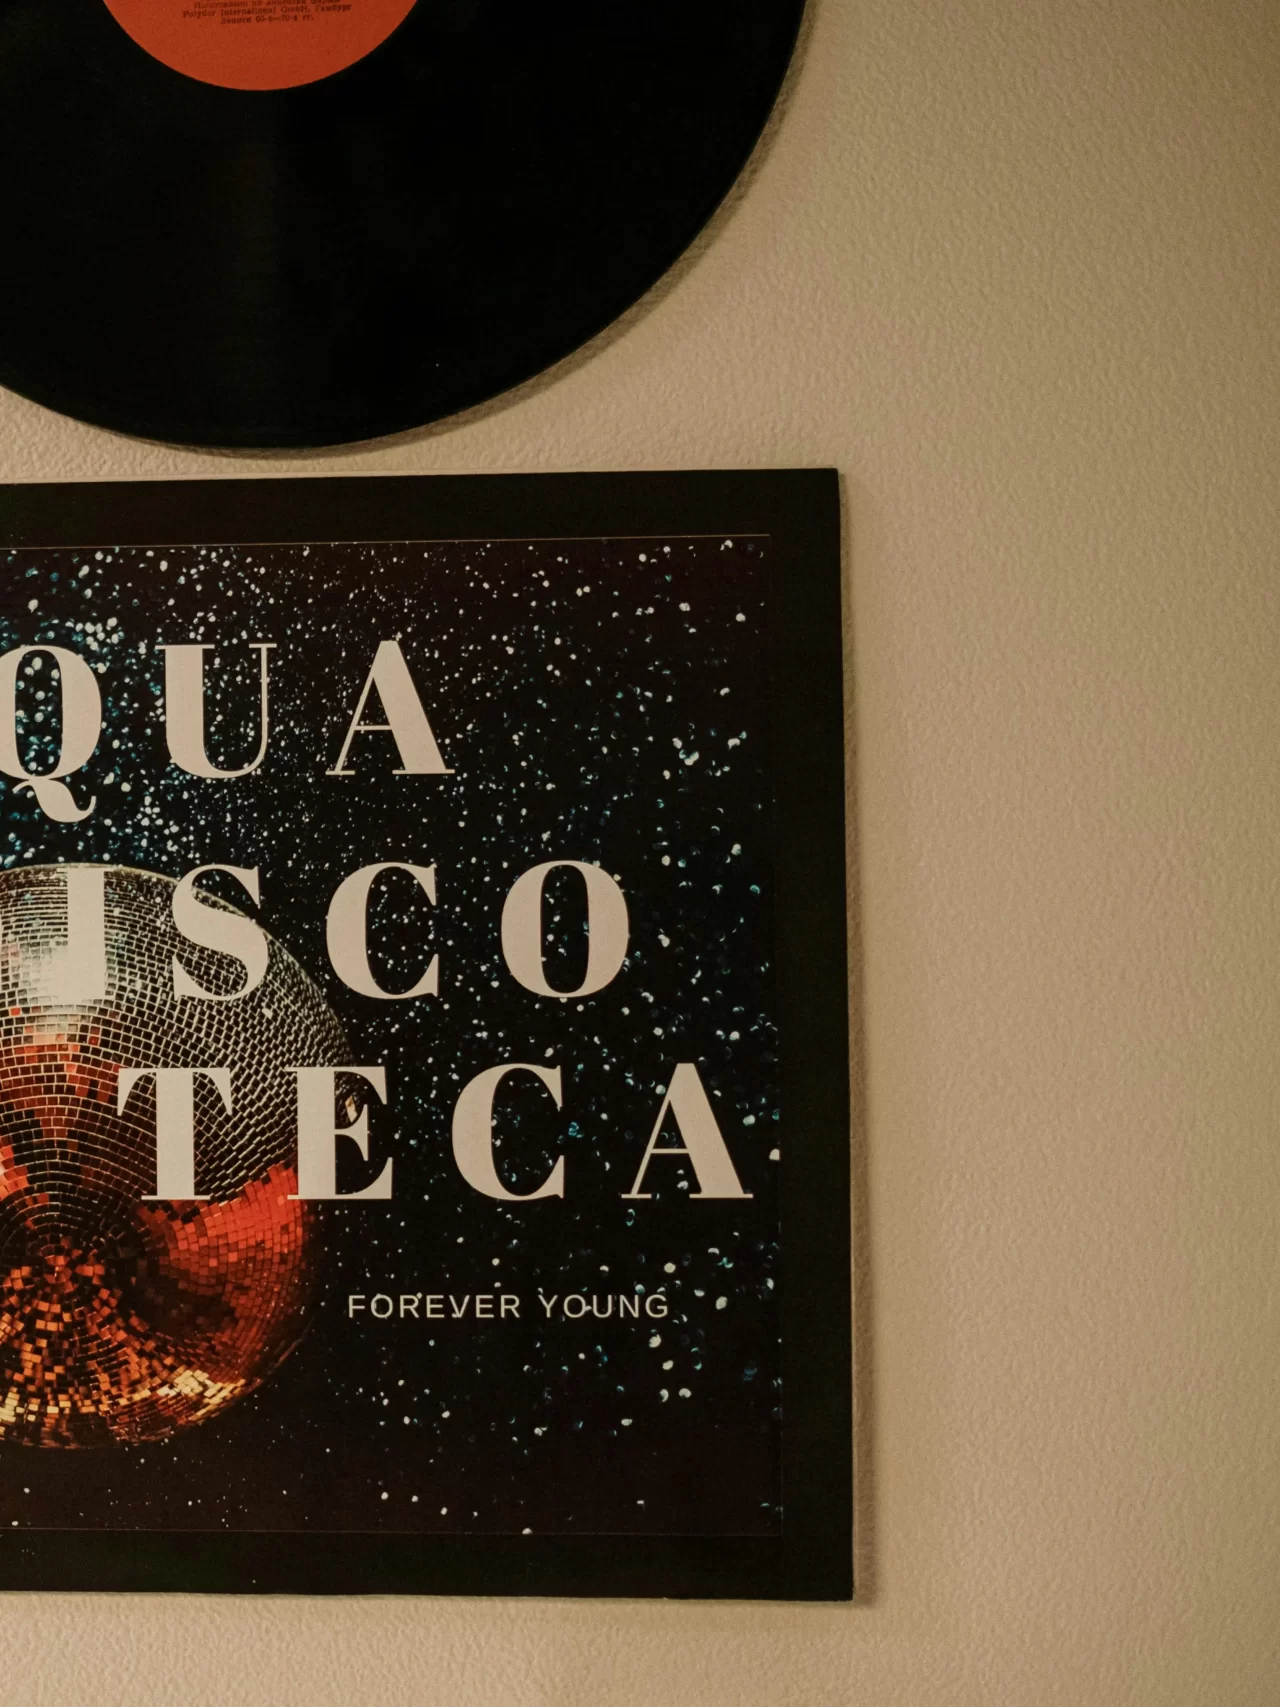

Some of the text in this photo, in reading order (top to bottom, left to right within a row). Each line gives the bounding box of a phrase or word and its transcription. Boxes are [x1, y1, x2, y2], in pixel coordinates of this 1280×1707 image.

[182, 10, 216, 19] Polydor
[220, 6, 276, 16] International
[117, 1062, 754, 1202] TECA
[348, 1294, 669, 1319] FOREVER YOUNG
